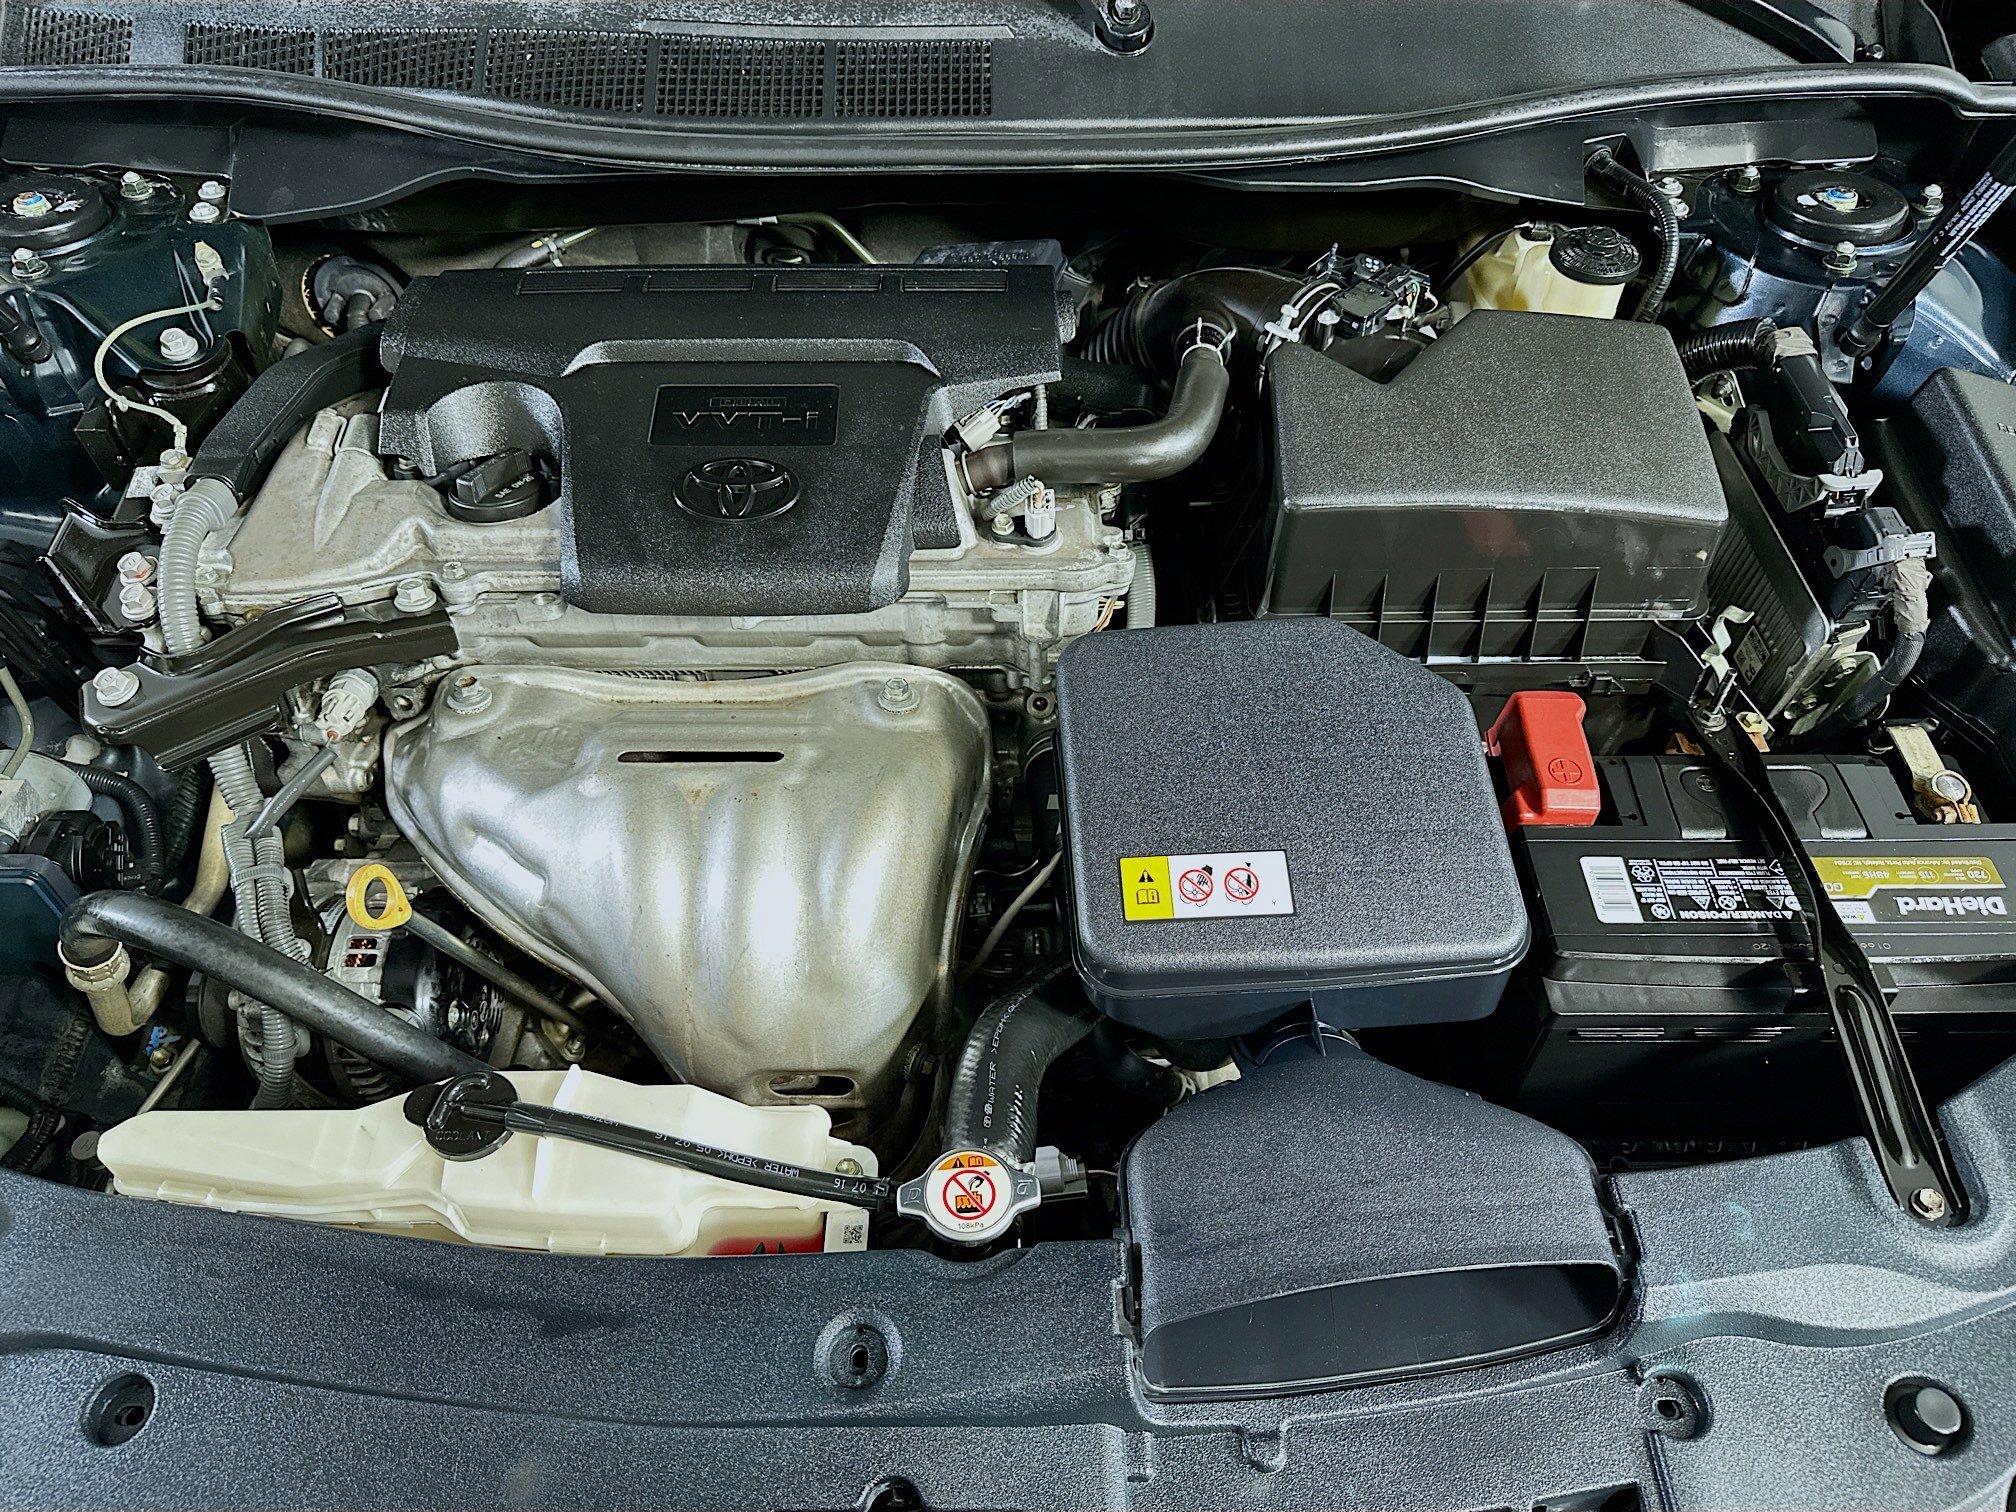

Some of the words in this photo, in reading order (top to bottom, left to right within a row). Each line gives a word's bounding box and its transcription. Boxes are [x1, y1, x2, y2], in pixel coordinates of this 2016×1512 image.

[672, 411, 819, 430] VVT-i
[1823, 882, 1844, 892] GO
[1896, 895, 2008, 916] DieHard
[1678, 910, 1783, 920] DANGER/POISON
[987, 1061, 997, 1104] WATER
[435, 1130, 491, 1142] COOLANT
[695, 1143, 711, 1154] 05
[764, 1161, 800, 1178] WATER
[833, 1177, 847, 1190] 16
[851, 1183, 867, 1195] 07
[957, 1221, 985, 1230] 108kPa
